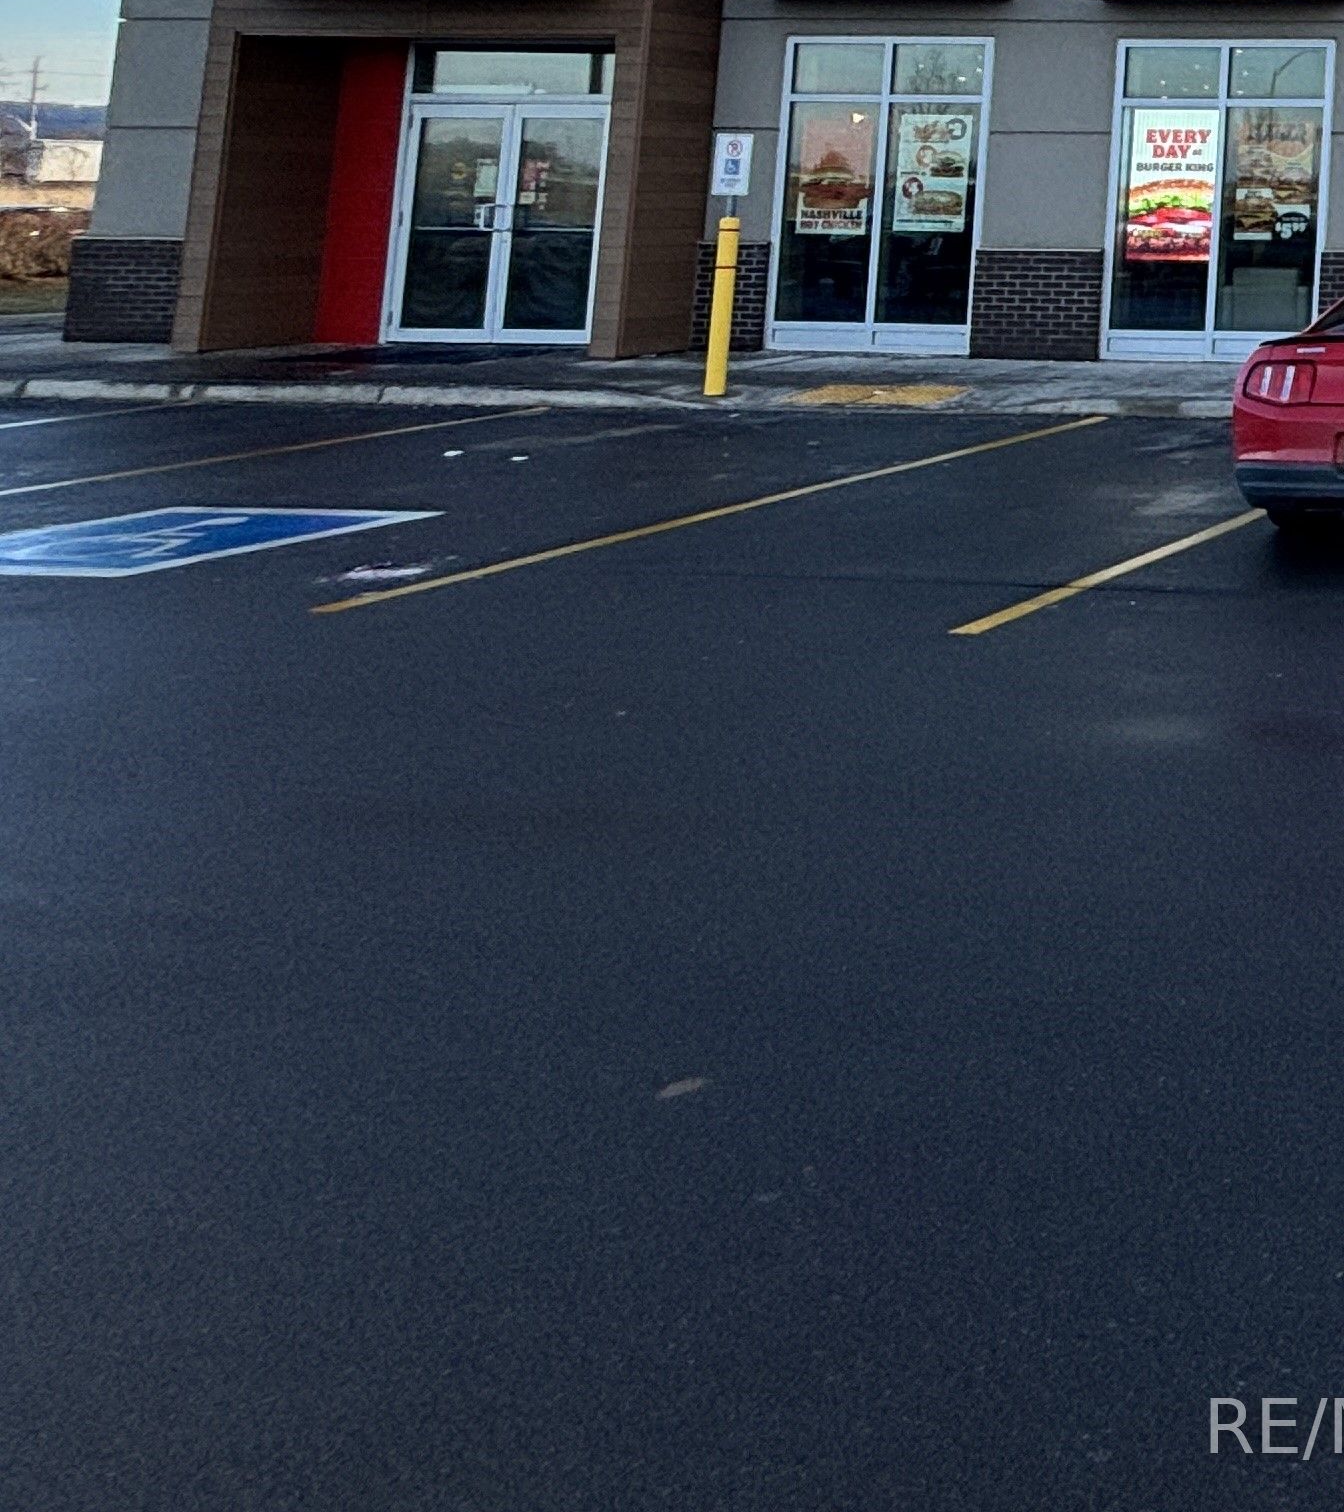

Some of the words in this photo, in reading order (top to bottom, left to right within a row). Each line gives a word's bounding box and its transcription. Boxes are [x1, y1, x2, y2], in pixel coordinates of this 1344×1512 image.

[1146, 128, 1211, 144] EVERY
[1152, 144, 1192, 159] DAY
[1136, 162, 1183, 172] BURGER
[1185, 162, 1214, 172] KING
[800, 209, 863, 221] NASHVILLE
